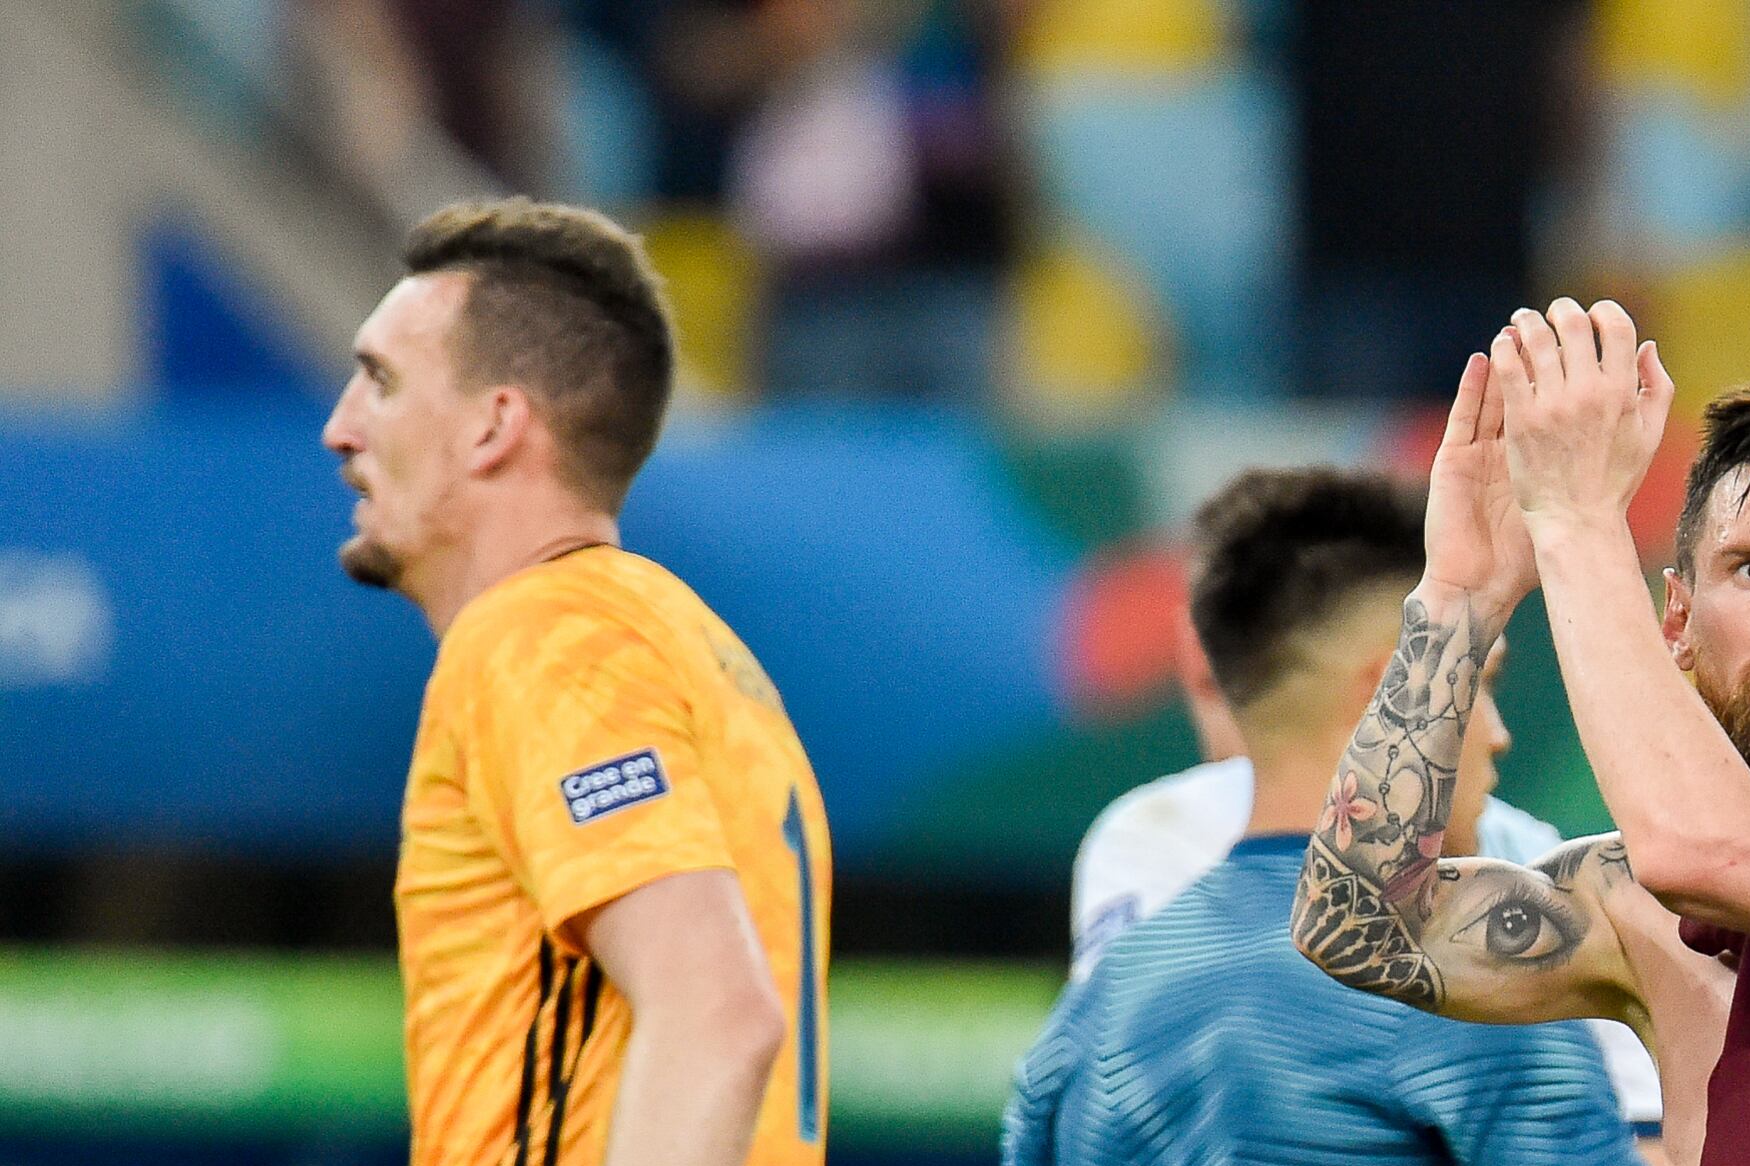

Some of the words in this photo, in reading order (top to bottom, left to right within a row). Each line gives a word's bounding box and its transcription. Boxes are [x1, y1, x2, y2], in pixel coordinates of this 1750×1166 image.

[563, 767, 620, 799] Cree
[620, 756, 656, 782] en
[571, 775, 658, 820] grande
